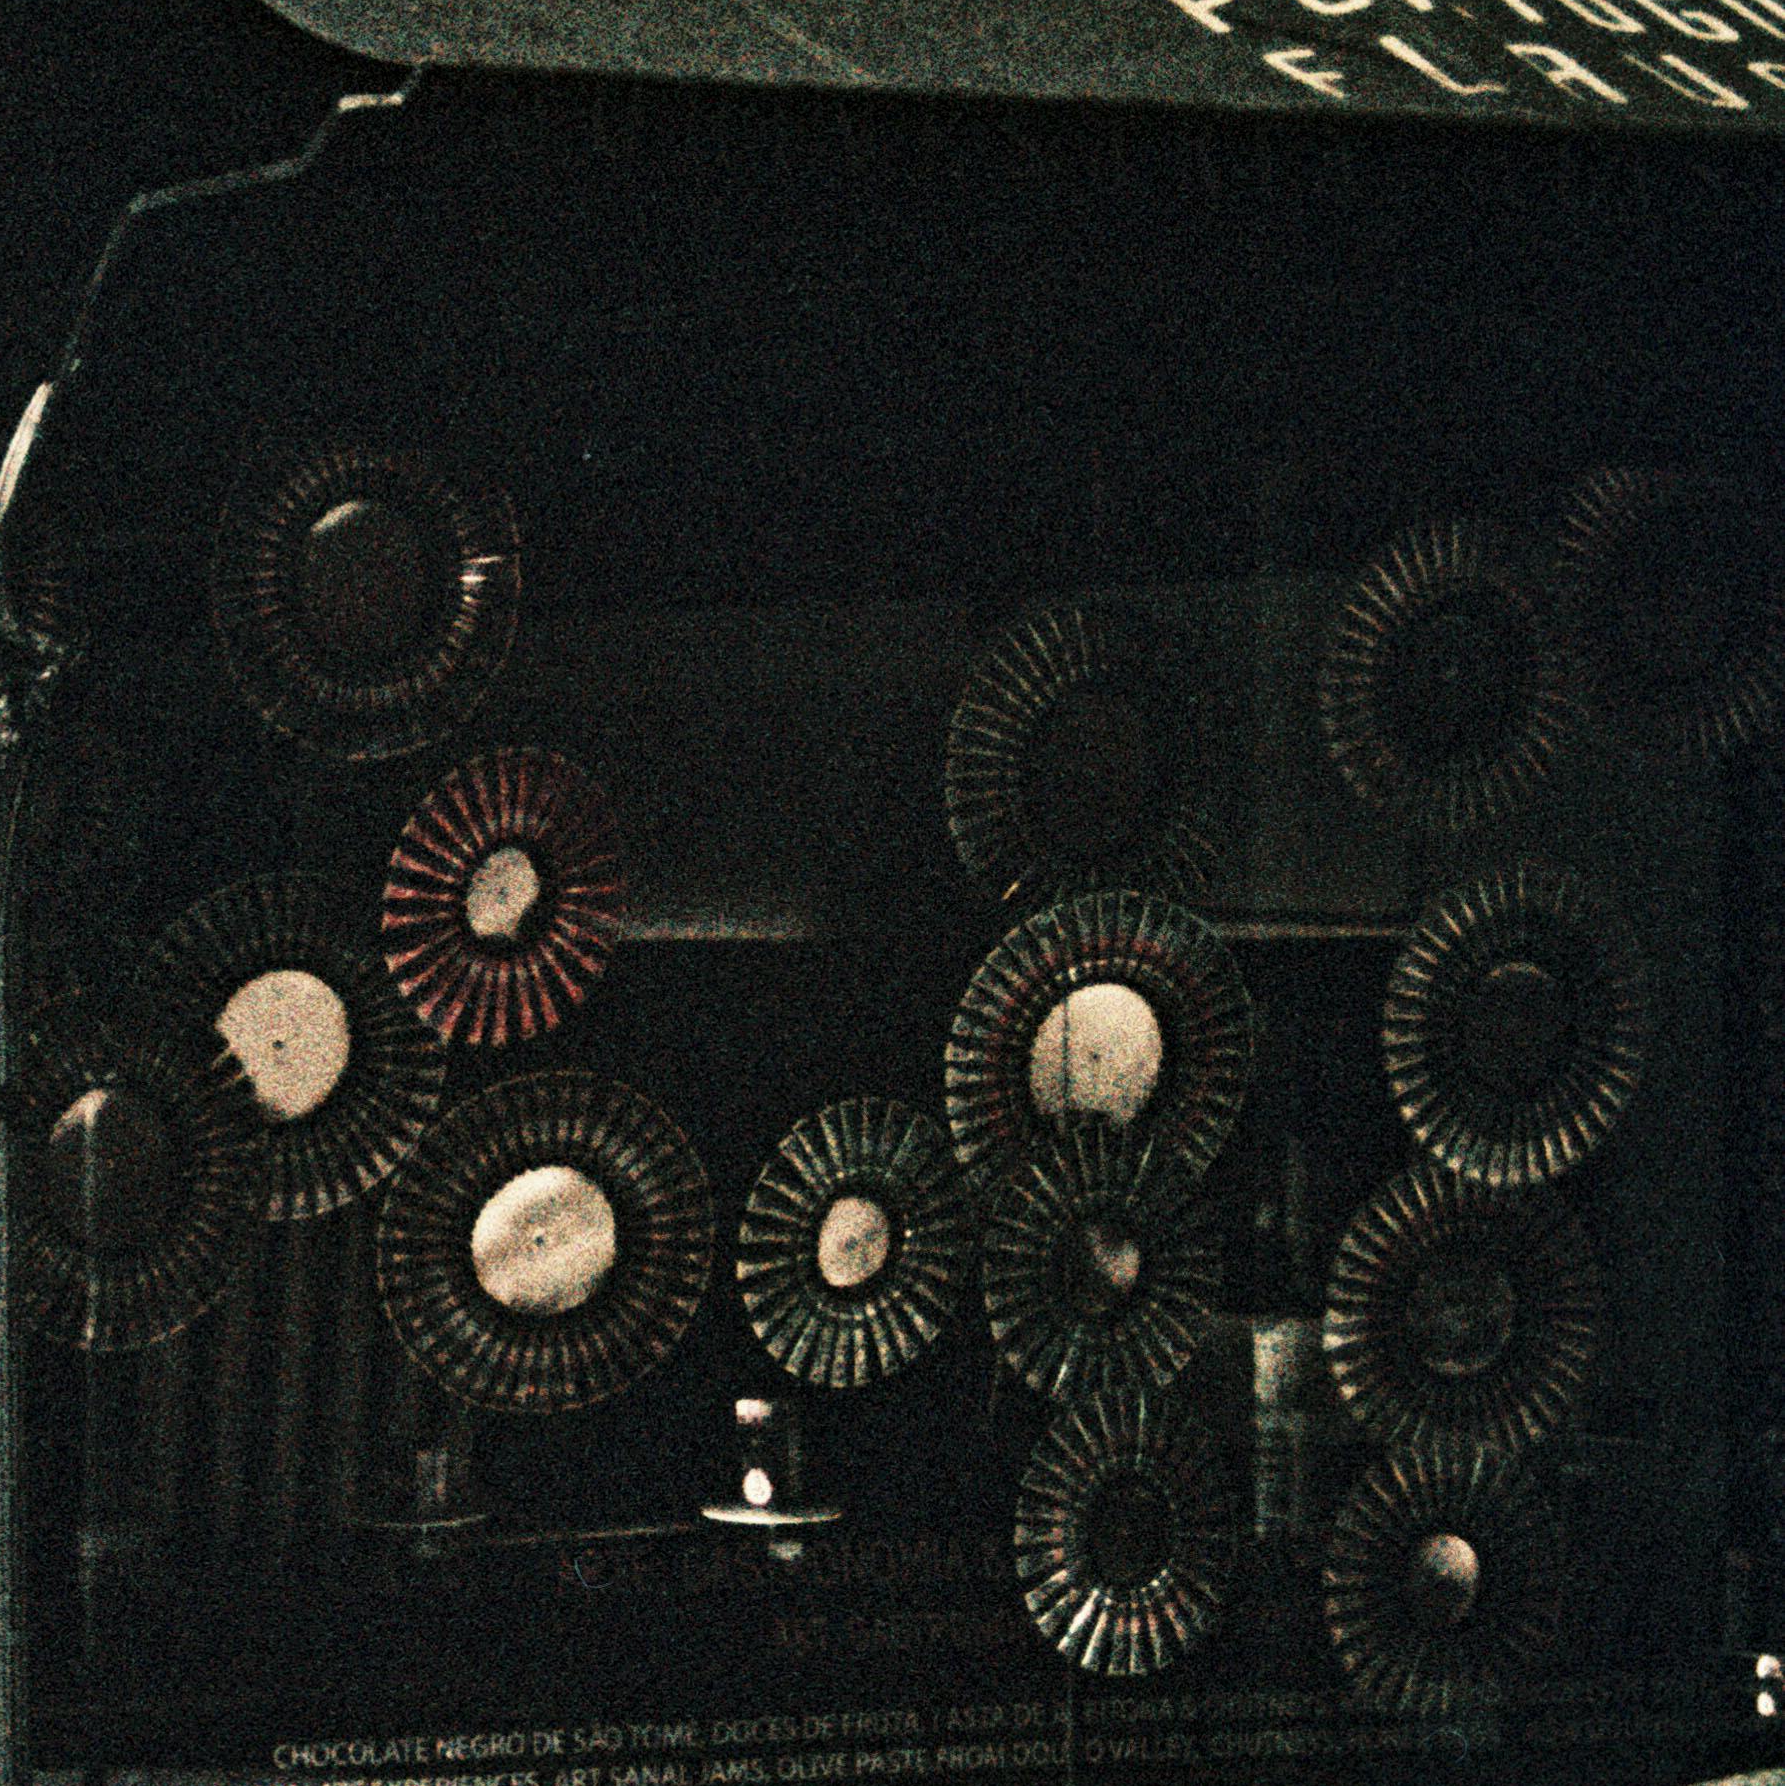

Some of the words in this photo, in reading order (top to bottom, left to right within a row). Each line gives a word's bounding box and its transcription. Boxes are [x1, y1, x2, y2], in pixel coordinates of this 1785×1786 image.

[272, 1736, 429, 1770] CHOCOLATE
[434, 1731, 526, 1761] NEGRO
[532, 1728, 566, 1757] DE
